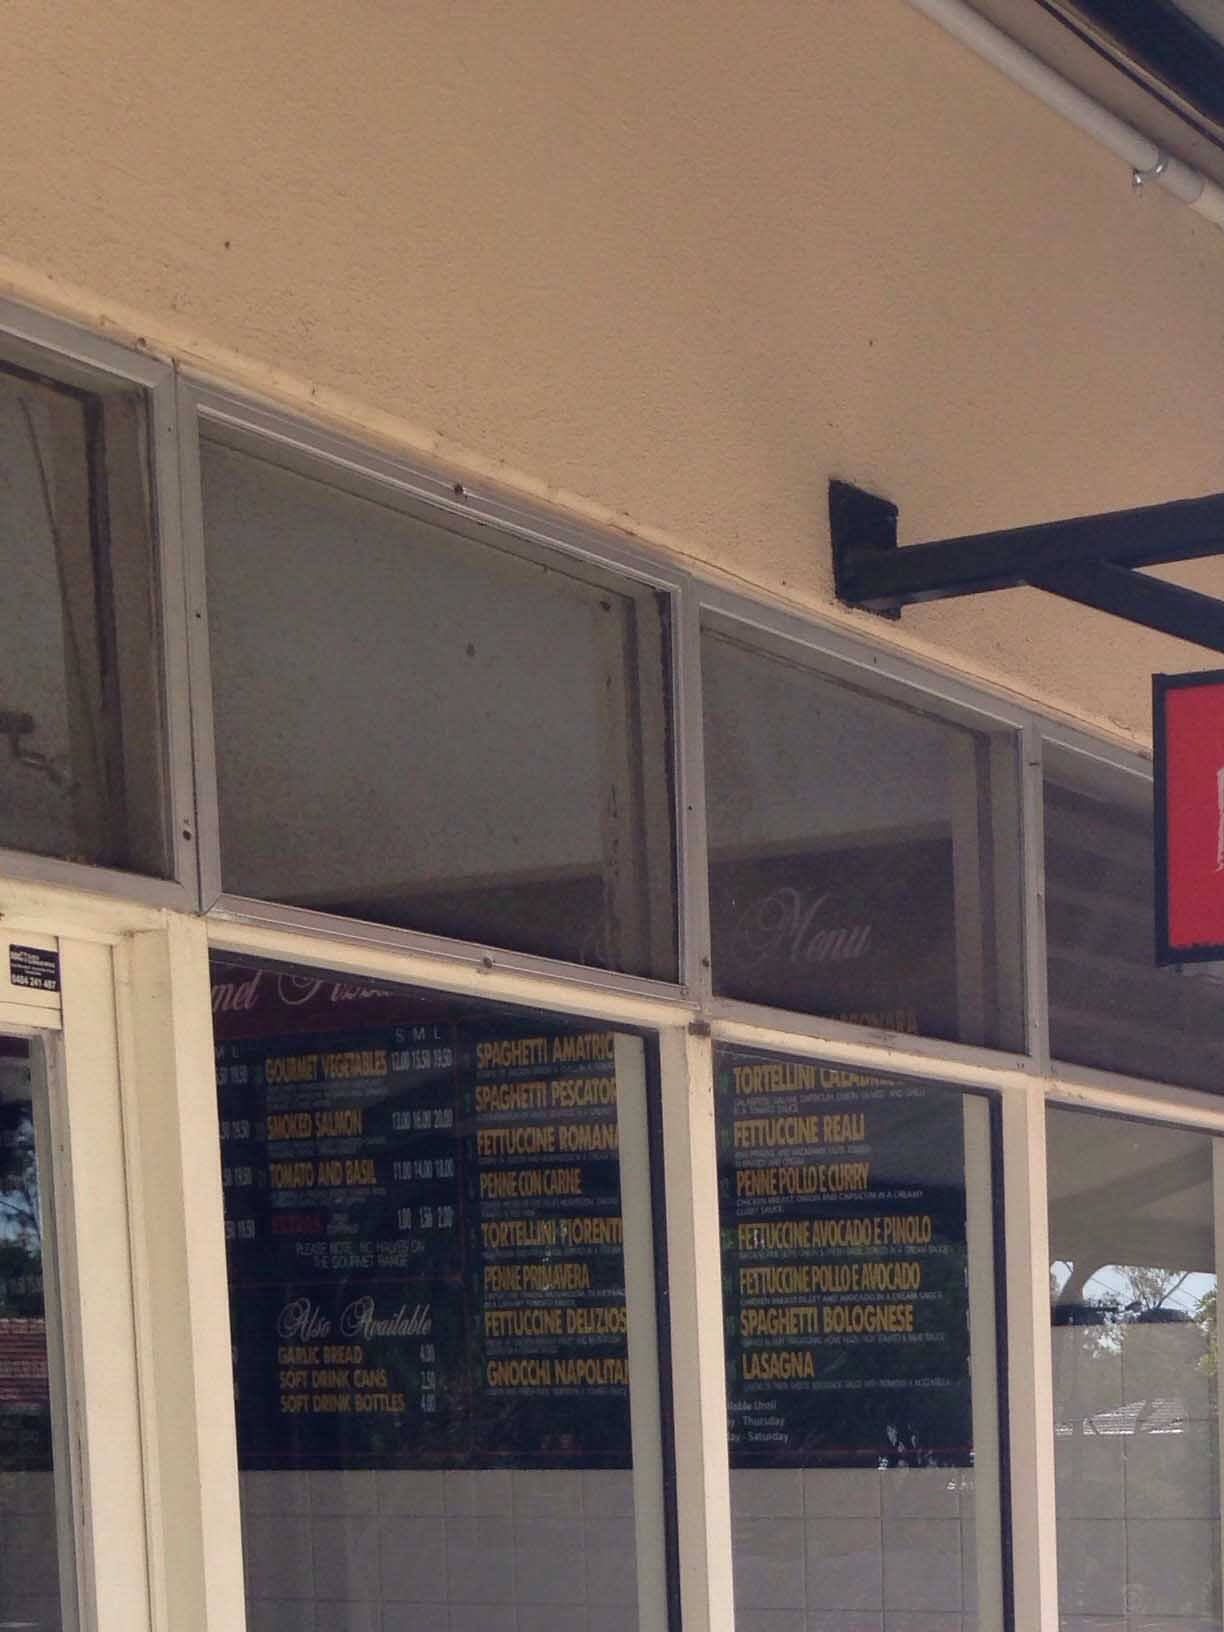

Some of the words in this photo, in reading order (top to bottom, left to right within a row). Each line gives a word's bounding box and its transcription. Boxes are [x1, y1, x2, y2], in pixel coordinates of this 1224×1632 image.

[476, 1037, 548, 1069] SPAGHETTI
[734, 1062, 817, 1094] TORTELLINI
[475, 1081, 547, 1112] SPAGHETTI
[314, 1108, 364, 1137] SALMON
[734, 1116, 819, 1148] FETTUCCINE
[823, 1113, 865, 1143] REALI
[478, 1127, 556, 1156] FETTUCCINE
[270, 1162, 314, 1187] TOMATO
[317, 1160, 343, 1186] AND
[345, 1159, 377, 1184] BASIL
[480, 1171, 518, 1198] PENNE
[519, 1170, 542, 1196] CON
[543, 1168, 582, 1195] CARNE
[736, 1168, 778, 1197] PENNE
[778, 1166, 818, 1195] POLLO
[819, 1165, 827, 1192] E
[827, 1162, 870, 1192] CURRY
[481, 1220, 556, 1248] TORTELLINI
[738, 1221, 811, 1250] FETTUCCINE
[811, 1219, 872, 1248] AVOCADO
[873, 1218, 882, 1245] E
[883, 1216, 932, 1245] PINOLO
[483, 1265, 521, 1291] PENNE
[523, 1264, 591, 1290] PRIMAVERA
[739, 1266, 811, 1296] FETTUCCINE
[812, 1264, 851, 1293] POLLO
[852, 1263, 860, 1290] E
[861, 1262, 921, 1291] AVOCADO
[340, 1295, 433, 1342] Available
[485, 1309, 563, 1337] FETTUCCINE
[740, 1307, 819, 1336] SPAGHETTI
[823, 1305, 914, 1333] BOLOGNESE
[278, 1344, 320, 1364] GARLIC
[323, 1344, 363, 1364] BREAD
[742, 1351, 815, 1380] LASAGNA
[279, 1370, 308, 1389] SOFT
[311, 1369, 349, 1389] DRINK
[353, 1369, 388, 1388] CANS
[487, 1360, 551, 1387] GNOCCHI
[280, 1394, 310, 1413] SOFT
[312, 1394, 352, 1413] DRINK
[354, 1393, 406, 1413] BOTTLES
